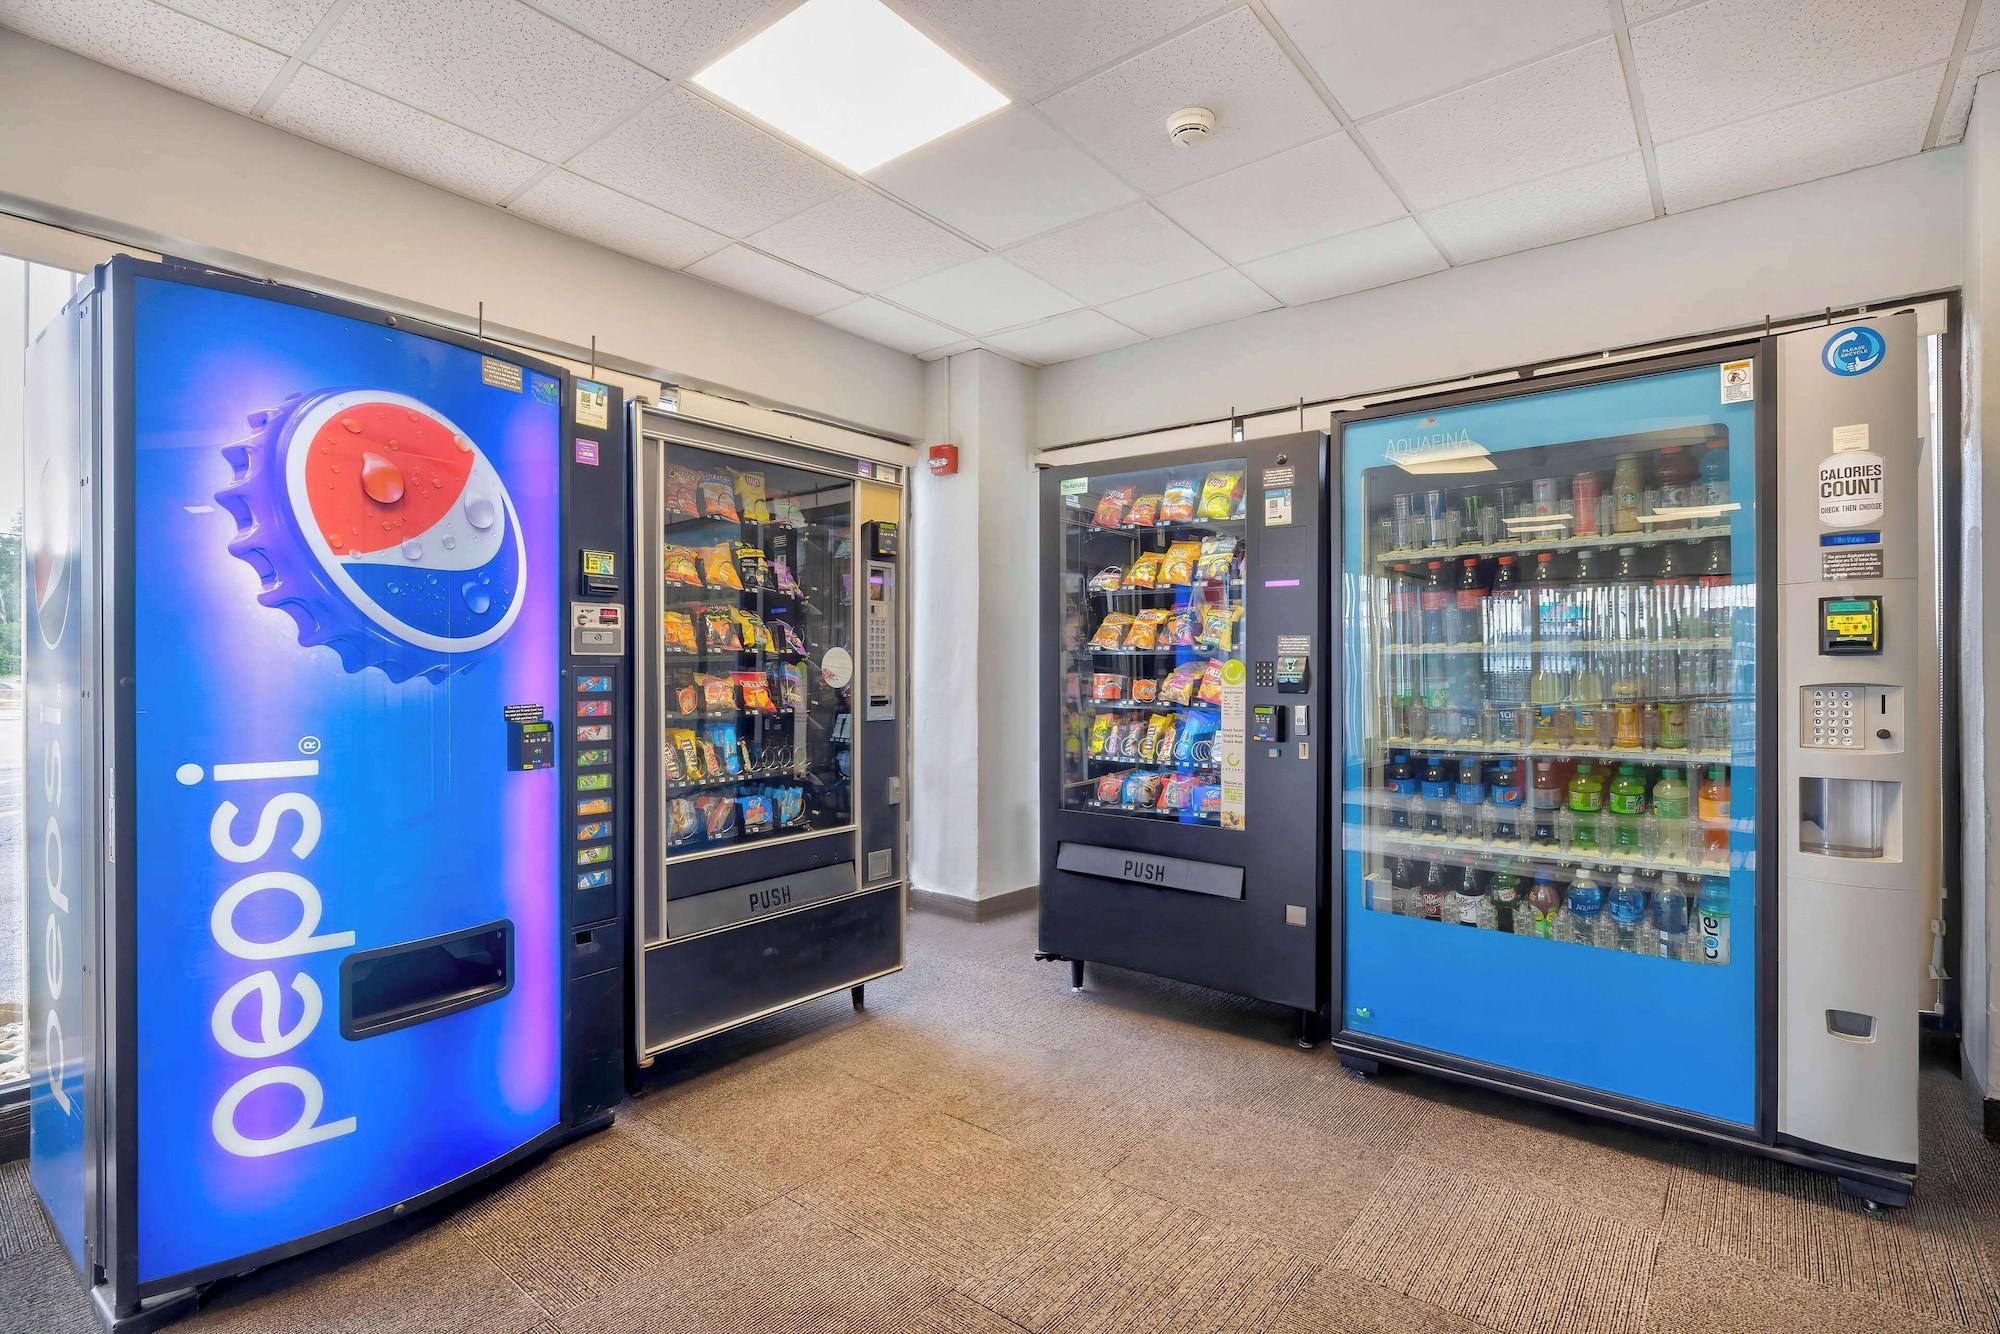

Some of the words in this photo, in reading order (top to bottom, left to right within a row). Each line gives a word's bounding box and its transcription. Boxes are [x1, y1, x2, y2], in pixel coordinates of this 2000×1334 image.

[1840, 349, 1868, 358] RECYCLE
[1842, 344, 1866, 354] PLEASE
[1385, 427, 1471, 460] AQUAFINA
[1820, 464, 1882, 481] CALORIES
[1820, 477, 1882, 498] COUNT
[1820, 506, 1840, 514] CHECK
[1842, 504, 1857, 512] THEN
[1859, 502, 1882, 511] CHOOSE
[1124, 860, 1164, 882] PUSH
[750, 885, 791, 912] PUSH
[40, 704, 70, 1117] pepsi
[1703, 916, 1719, 960] core
[176, 760, 357, 1158] pepsi
